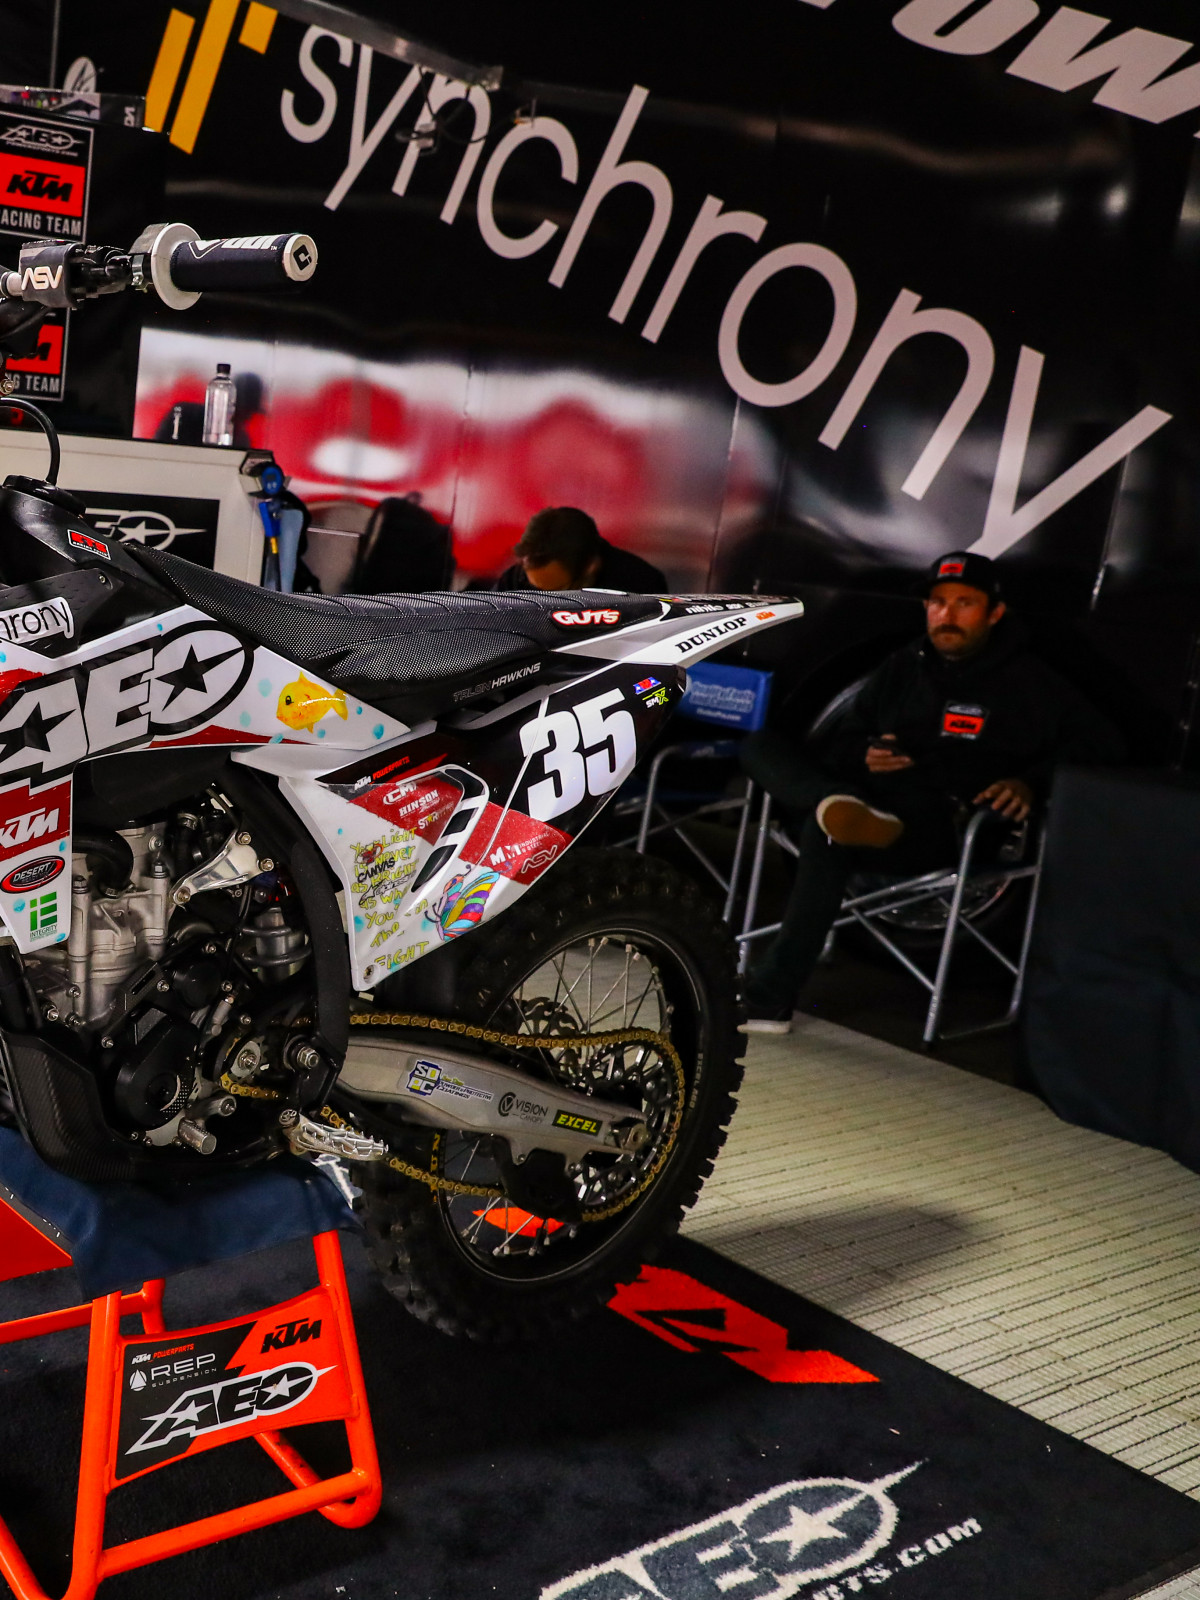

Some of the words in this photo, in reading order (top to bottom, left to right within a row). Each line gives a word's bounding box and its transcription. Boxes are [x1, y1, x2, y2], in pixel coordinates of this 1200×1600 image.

[6, 170, 73, 203] KTM
[46, 215, 81, 236] TEAM
[21, 265, 63, 291] ASV
[281, 25, 1172, 557] synchrony
[25, 374, 60, 393] TEAM
[553, 608, 621, 626] GUTS
[675, 616, 748, 653] DUNLOP
[453, 680, 492, 702] TALON
[491, 662, 541, 689] HAWKINS
[519, 688, 637, 822] 35
[399, 789, 439, 816] HINSON
[13, 862, 50, 882] DESERT
[357, 857, 396, 883] CANVAS
[521, 845, 557, 874] ASV
[30, 924, 57, 938] INTEGRITY
[515, 1101, 549, 1117] VISION
[519, 1113, 544, 1124] CANOPY
[557, 1113, 597, 1133] EXCEL
[260, 1318, 322, 1354] KTM
[131, 1353, 151, 1365] KTM
[153, 1343, 195, 1358] POWERPARTS
[151, 1352, 216, 1381] REP
[152, 1368, 217, 1388] SUSPENSION
[124, 1361, 338, 1456] AEO
